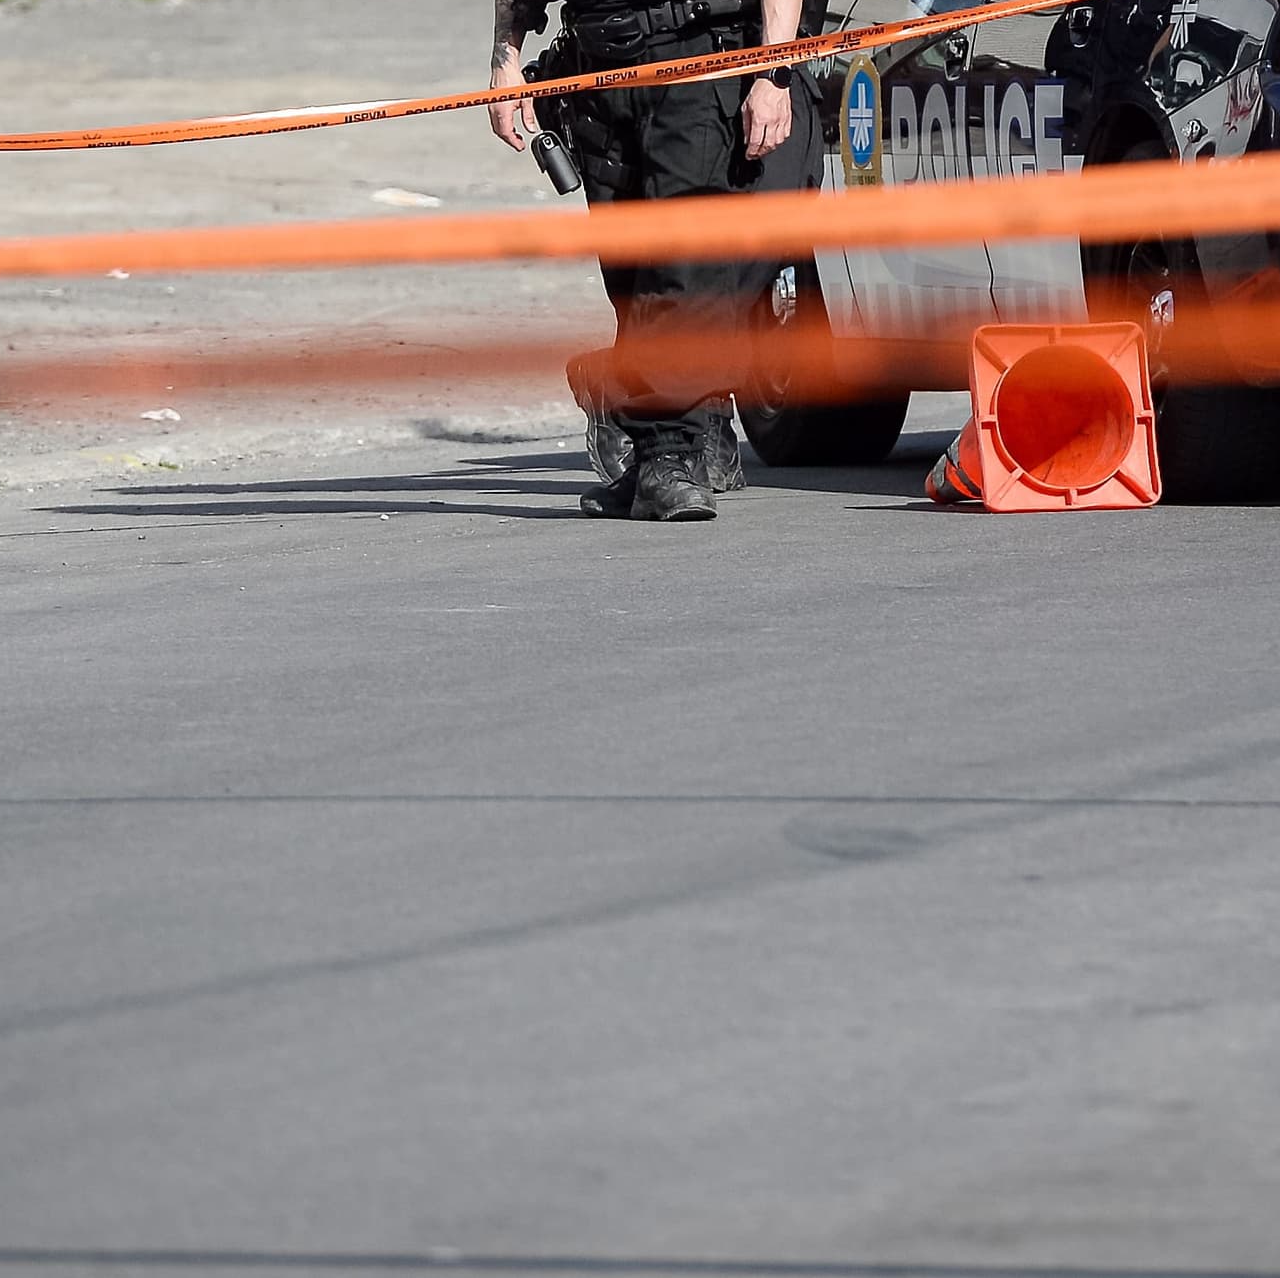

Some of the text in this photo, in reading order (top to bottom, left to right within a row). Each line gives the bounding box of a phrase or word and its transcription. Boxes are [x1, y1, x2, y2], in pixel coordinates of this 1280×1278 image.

[655, 61, 703, 76] POLICE
[768, 40, 828, 55] INTERDIT
[891, 81, 1065, 186] POLICE
